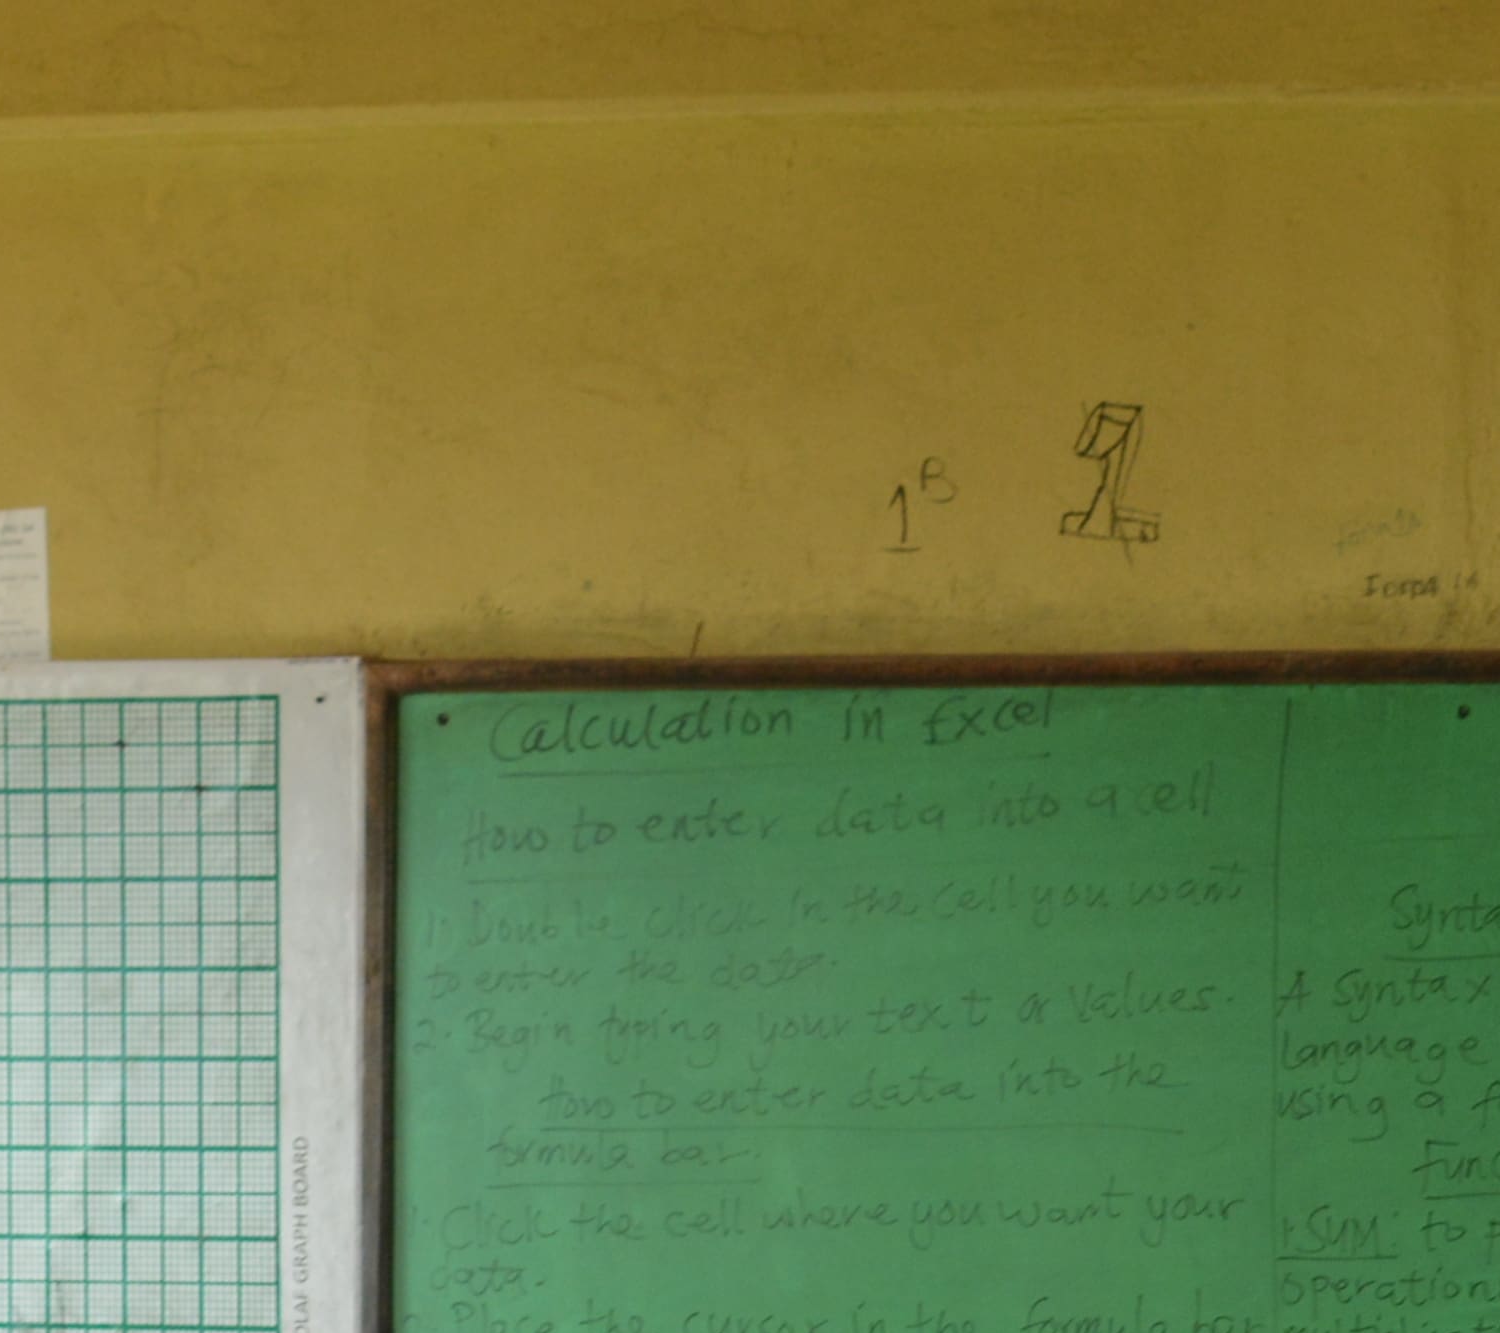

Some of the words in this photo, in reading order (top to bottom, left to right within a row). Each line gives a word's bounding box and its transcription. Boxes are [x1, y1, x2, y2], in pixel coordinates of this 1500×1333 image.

[489, 700, 793, 759] Calculation
[844, 702, 885, 743] in
[923, 690, 1052, 746] Excel
[571, 807, 616, 854] to
[639, 797, 779, 840] enter
[815, 788, 944, 838] data
[978, 782, 1059, 829] into
[1140, 762, 1214, 817] cell
[844, 884, 923, 920] the
[933, 878, 1016, 920] cell
[1030, 879, 1110, 932] you
[1129, 865, 1246, 910] want
[617, 950, 685, 984] the
[466, 1008, 574, 1073] Begin
[599, 1006, 719, 1071] typing
[757, 1010, 851, 1062] your
[1280, 1031, 1490, 1084] language
[632, 1073, 675, 1118] to
[693, 1069, 827, 1116] enter
[849, 1066, 975, 1109] data
[998, 1059, 1079, 1100] into
[1099, 1055, 1191, 1095] the
[1276, 1082, 1387, 1141] using
[1415, 1089, 1445, 1114] a
[292, 1135, 309, 1207] BOARD
[441, 1202, 556, 1255] Click
[568, 1206, 647, 1243] the
[665, 1195, 747, 1239] cell
[761, 1190, 898, 1231] where
[912, 1199, 987, 1248] you
[1004, 1171, 1124, 1226] want
[1143, 1193, 1242, 1248] your
[1421, 1210, 1466, 1252] to
[292, 1214, 309, 1285] GRAPH
